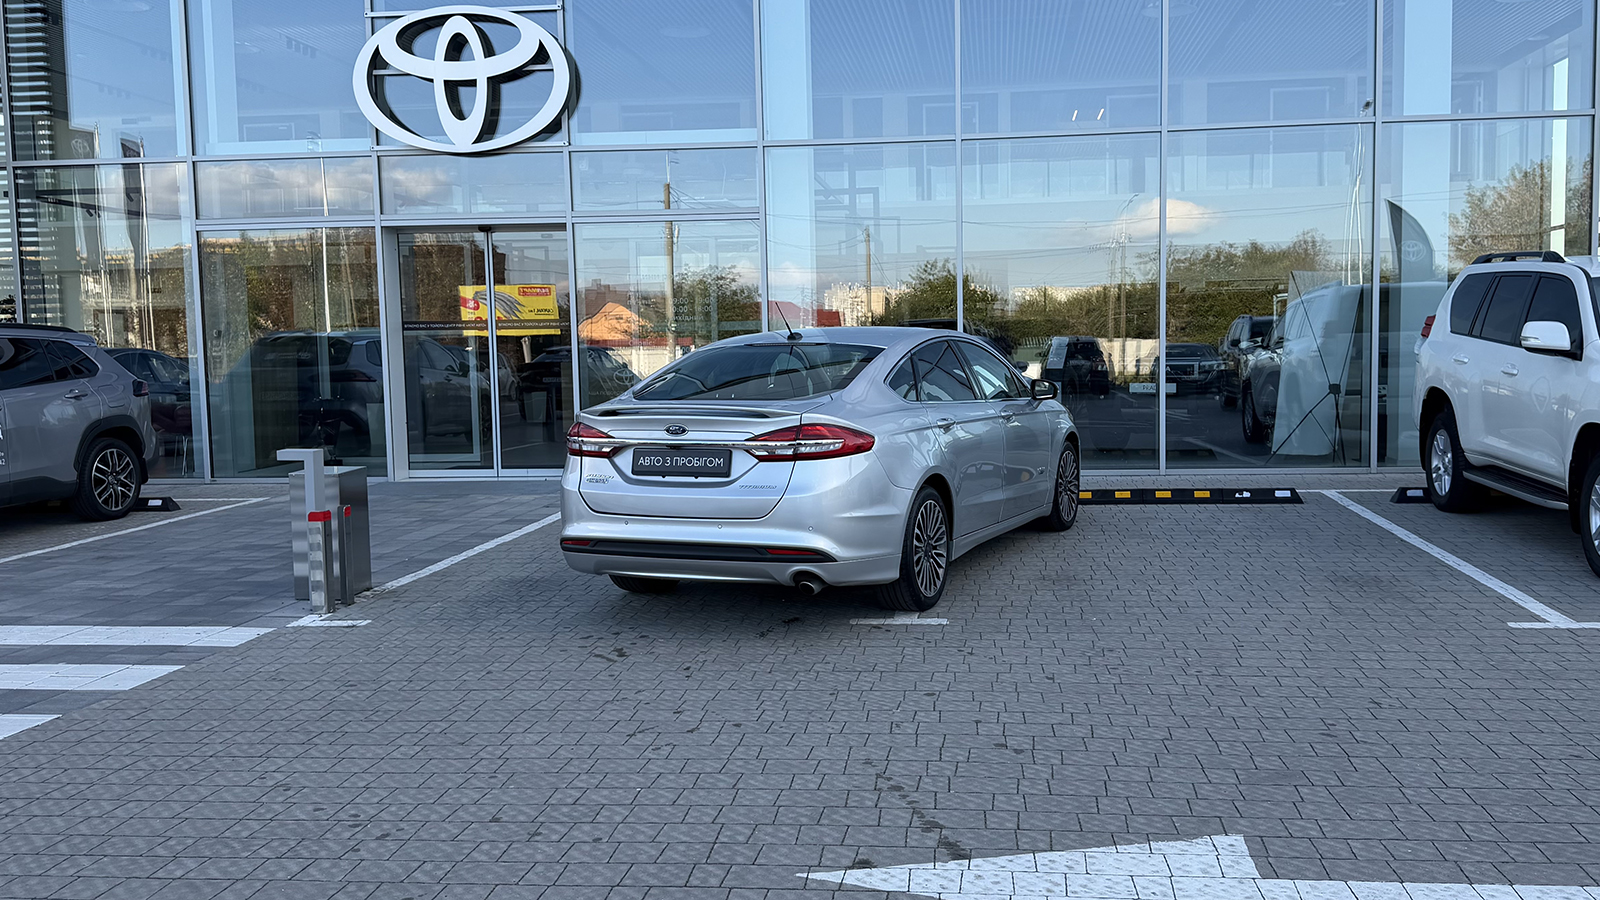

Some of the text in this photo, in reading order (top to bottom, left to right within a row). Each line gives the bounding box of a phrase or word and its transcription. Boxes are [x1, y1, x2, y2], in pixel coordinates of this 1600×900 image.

[638, 457, 724, 467] АВТО З ПРОБІГОМ
